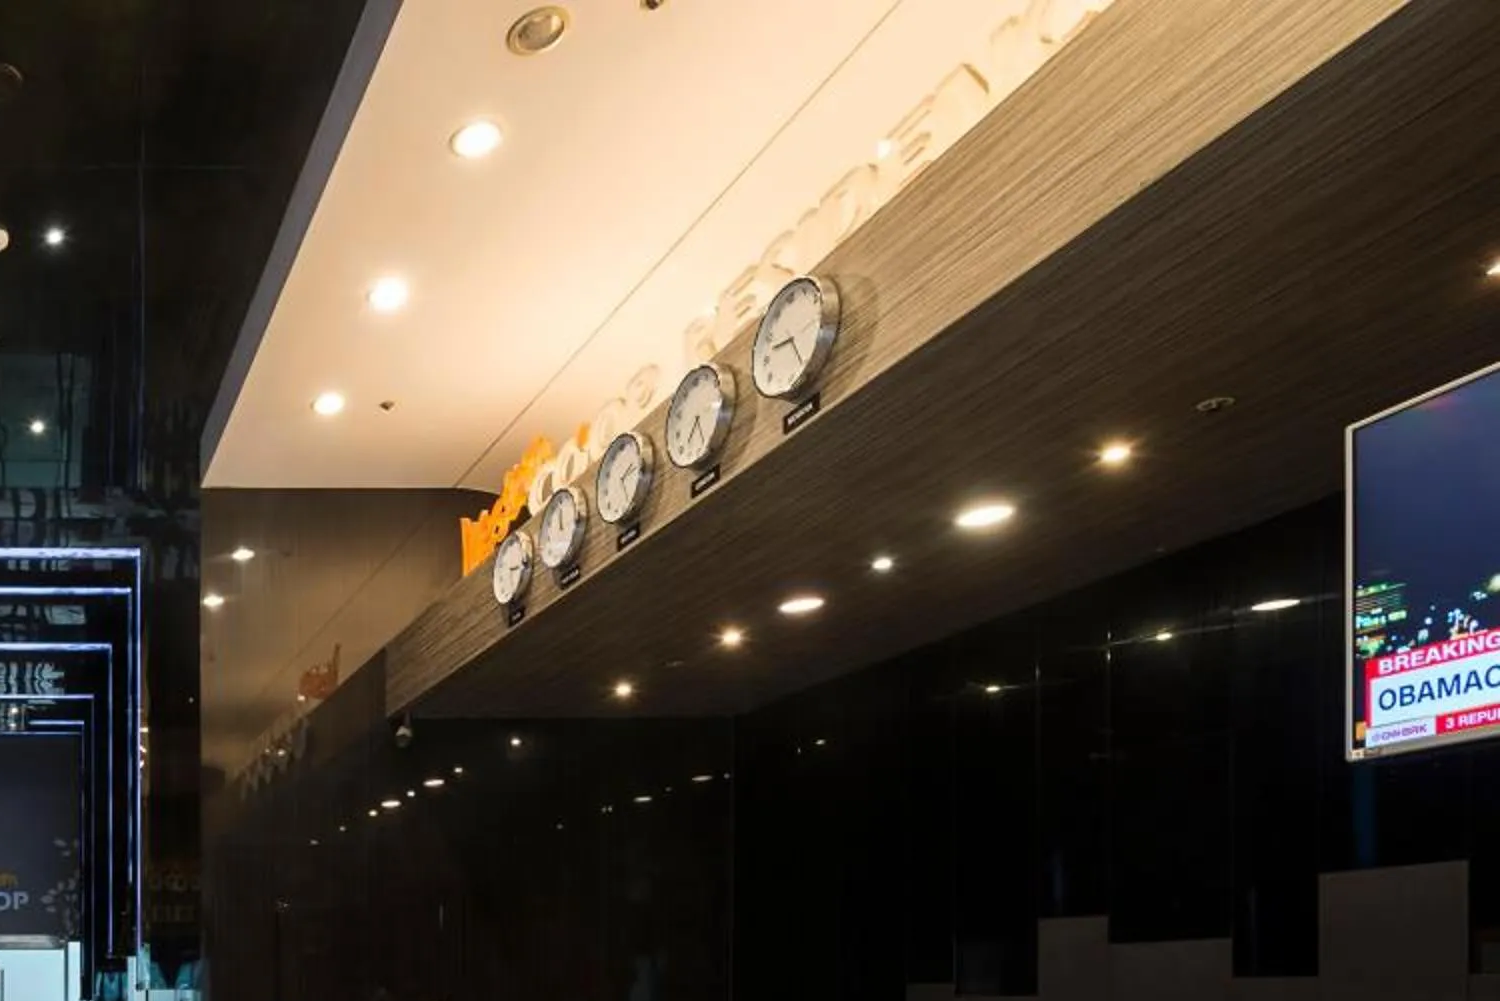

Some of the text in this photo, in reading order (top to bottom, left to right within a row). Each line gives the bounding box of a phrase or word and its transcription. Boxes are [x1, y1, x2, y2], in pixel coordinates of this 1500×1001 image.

[1378, 631, 1500, 675] BREAKING
[1378, 664, 1500, 711] OBAMAC
[1458, 708, 1500, 726] REPU
